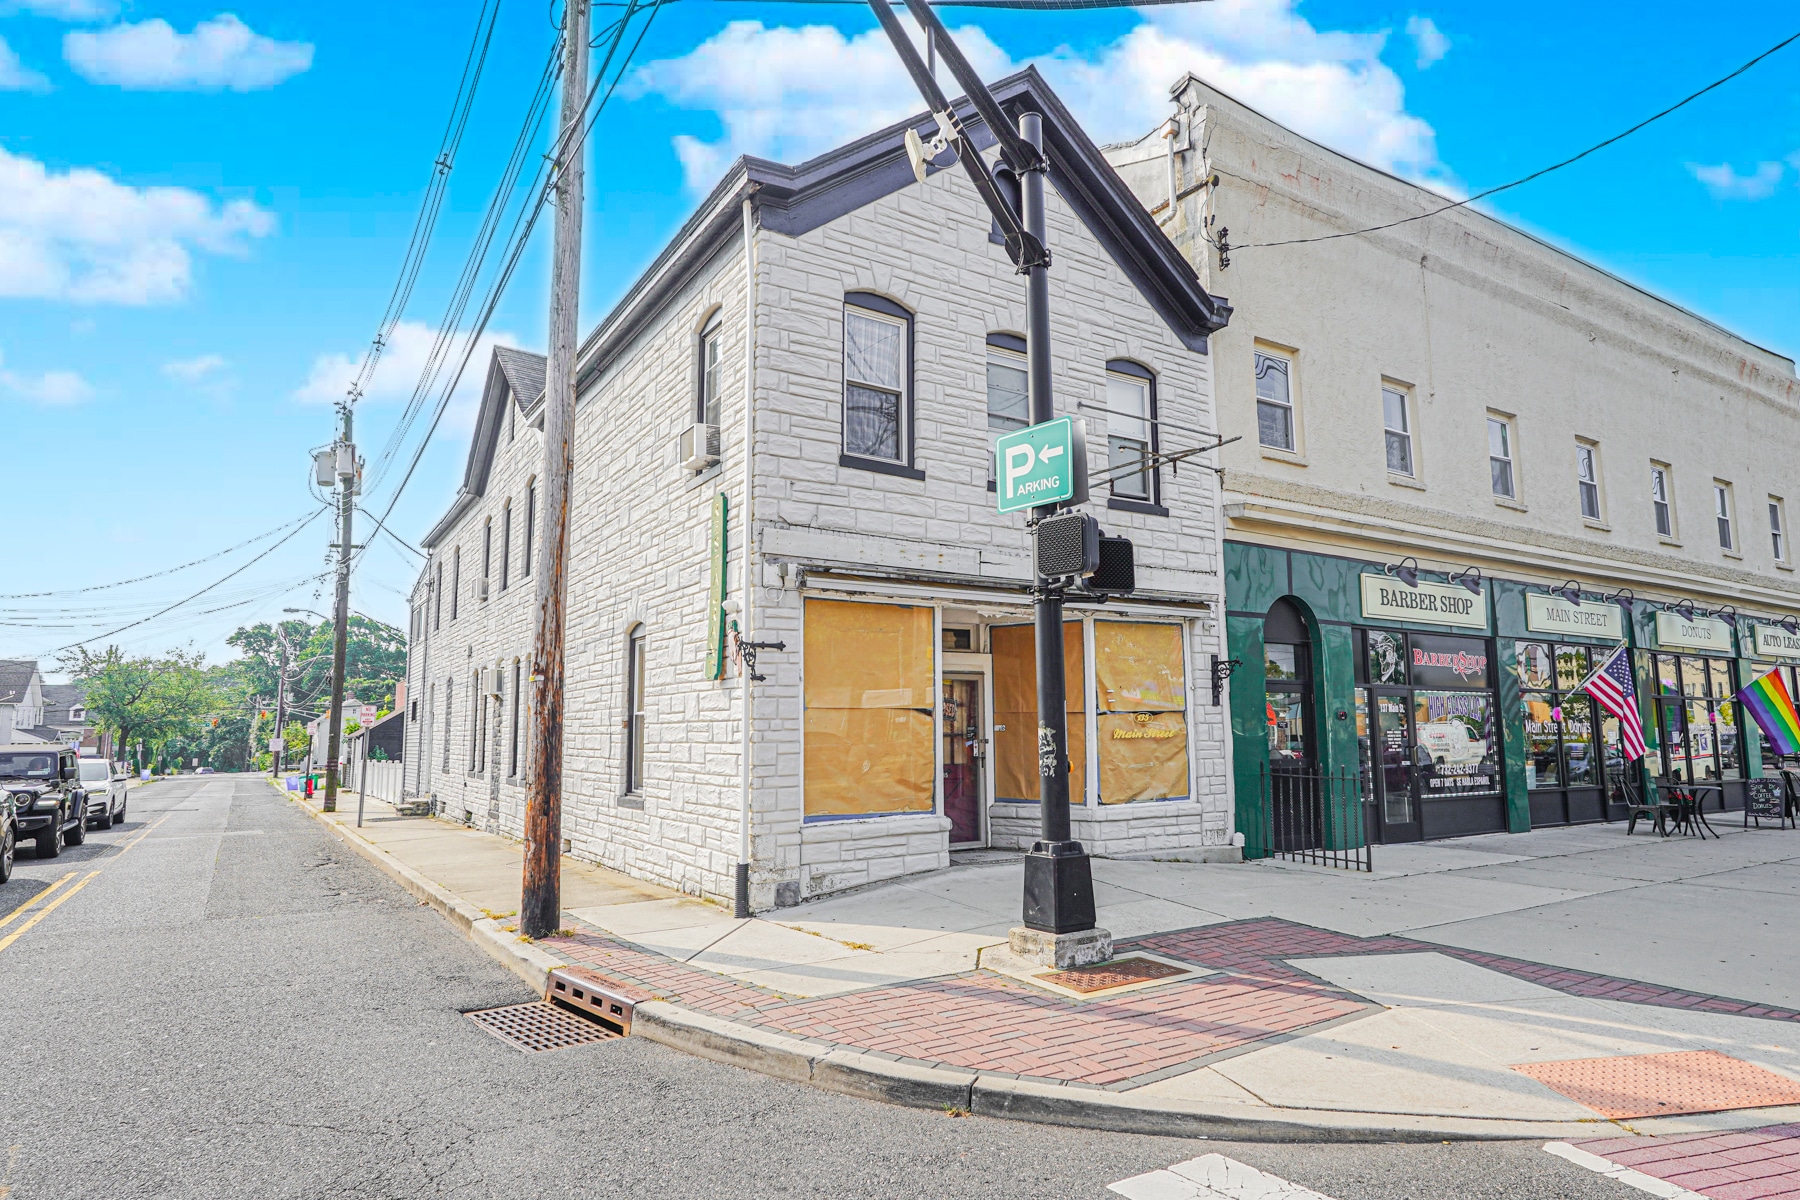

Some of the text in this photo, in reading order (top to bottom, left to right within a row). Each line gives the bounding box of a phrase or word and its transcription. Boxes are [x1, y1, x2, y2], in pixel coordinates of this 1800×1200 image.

[1006, 443, 1060, 499] PARKING
[1380, 588, 1473, 615] BARBER SHOP
[1546, 608, 1607, 627] MAIN STREET
[1681, 625, 1711, 640] DONUTS
[1763, 633, 1782, 648] AUTO
[1388, 703, 1399, 713] Main
[1428, 695, 1481, 722] HIGH CLASS LLC
[1113, 728, 1176, 739] Main Street
[1525, 720, 1591, 734] Main Stret Donuts
[1430, 778, 1441, 788] OPEN
